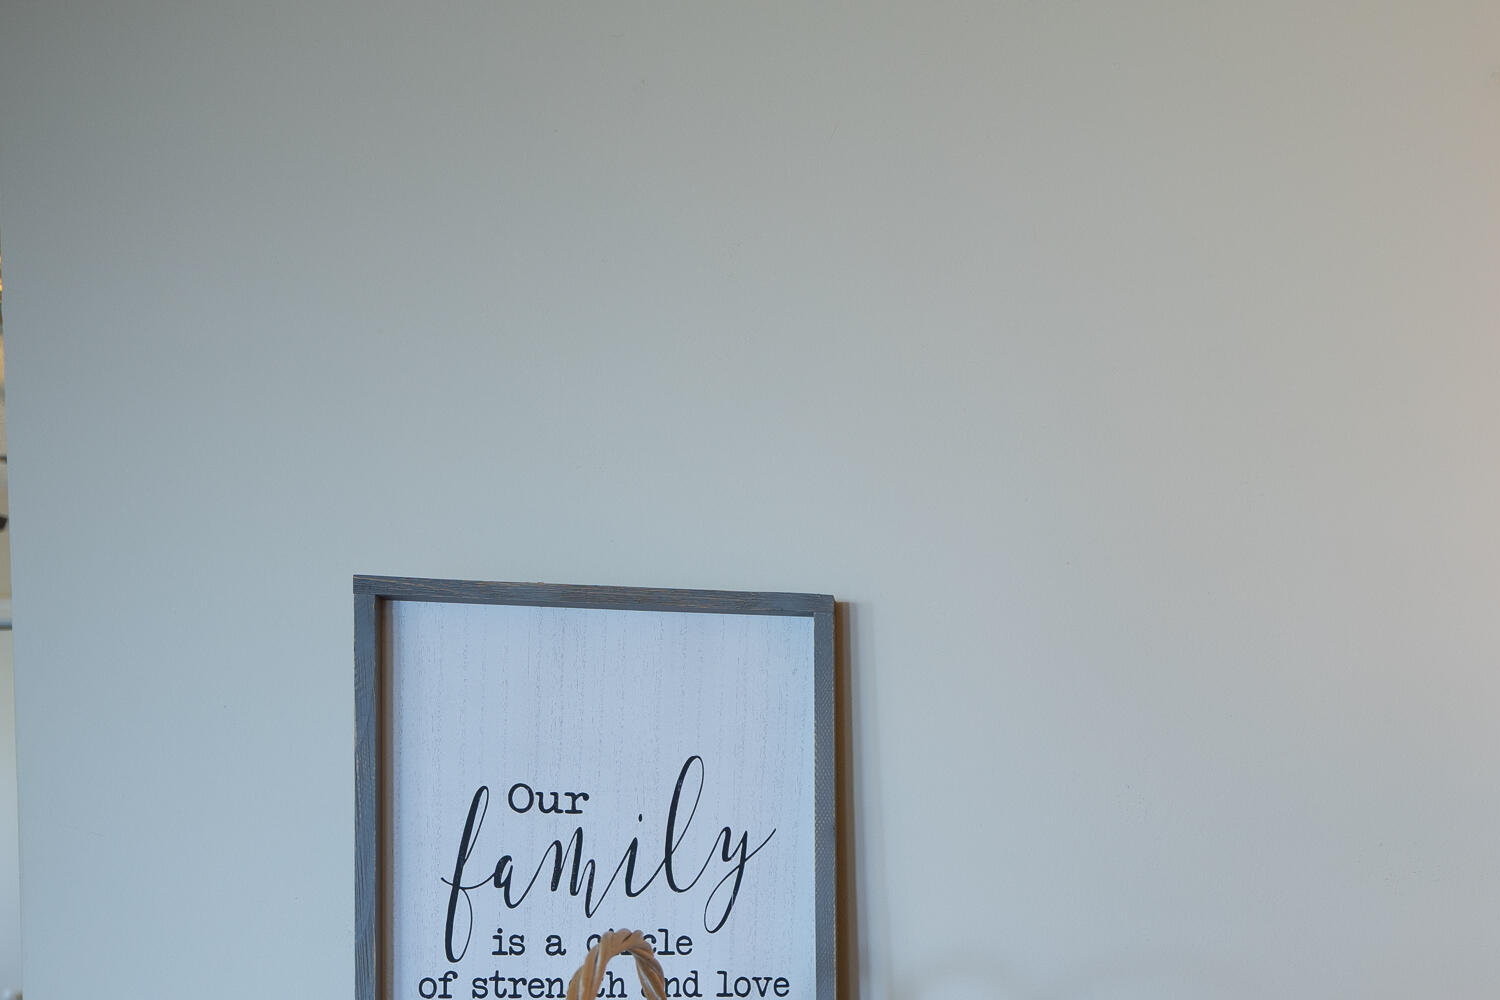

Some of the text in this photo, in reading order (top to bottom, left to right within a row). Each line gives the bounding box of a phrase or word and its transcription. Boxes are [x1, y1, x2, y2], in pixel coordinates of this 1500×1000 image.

[507, 782, 590, 814] Our
[440, 755, 777, 963] family
[491, 928, 525, 956] is
[545, 934, 567, 956] a
[418, 969, 790, 1000] of strenh nd love
